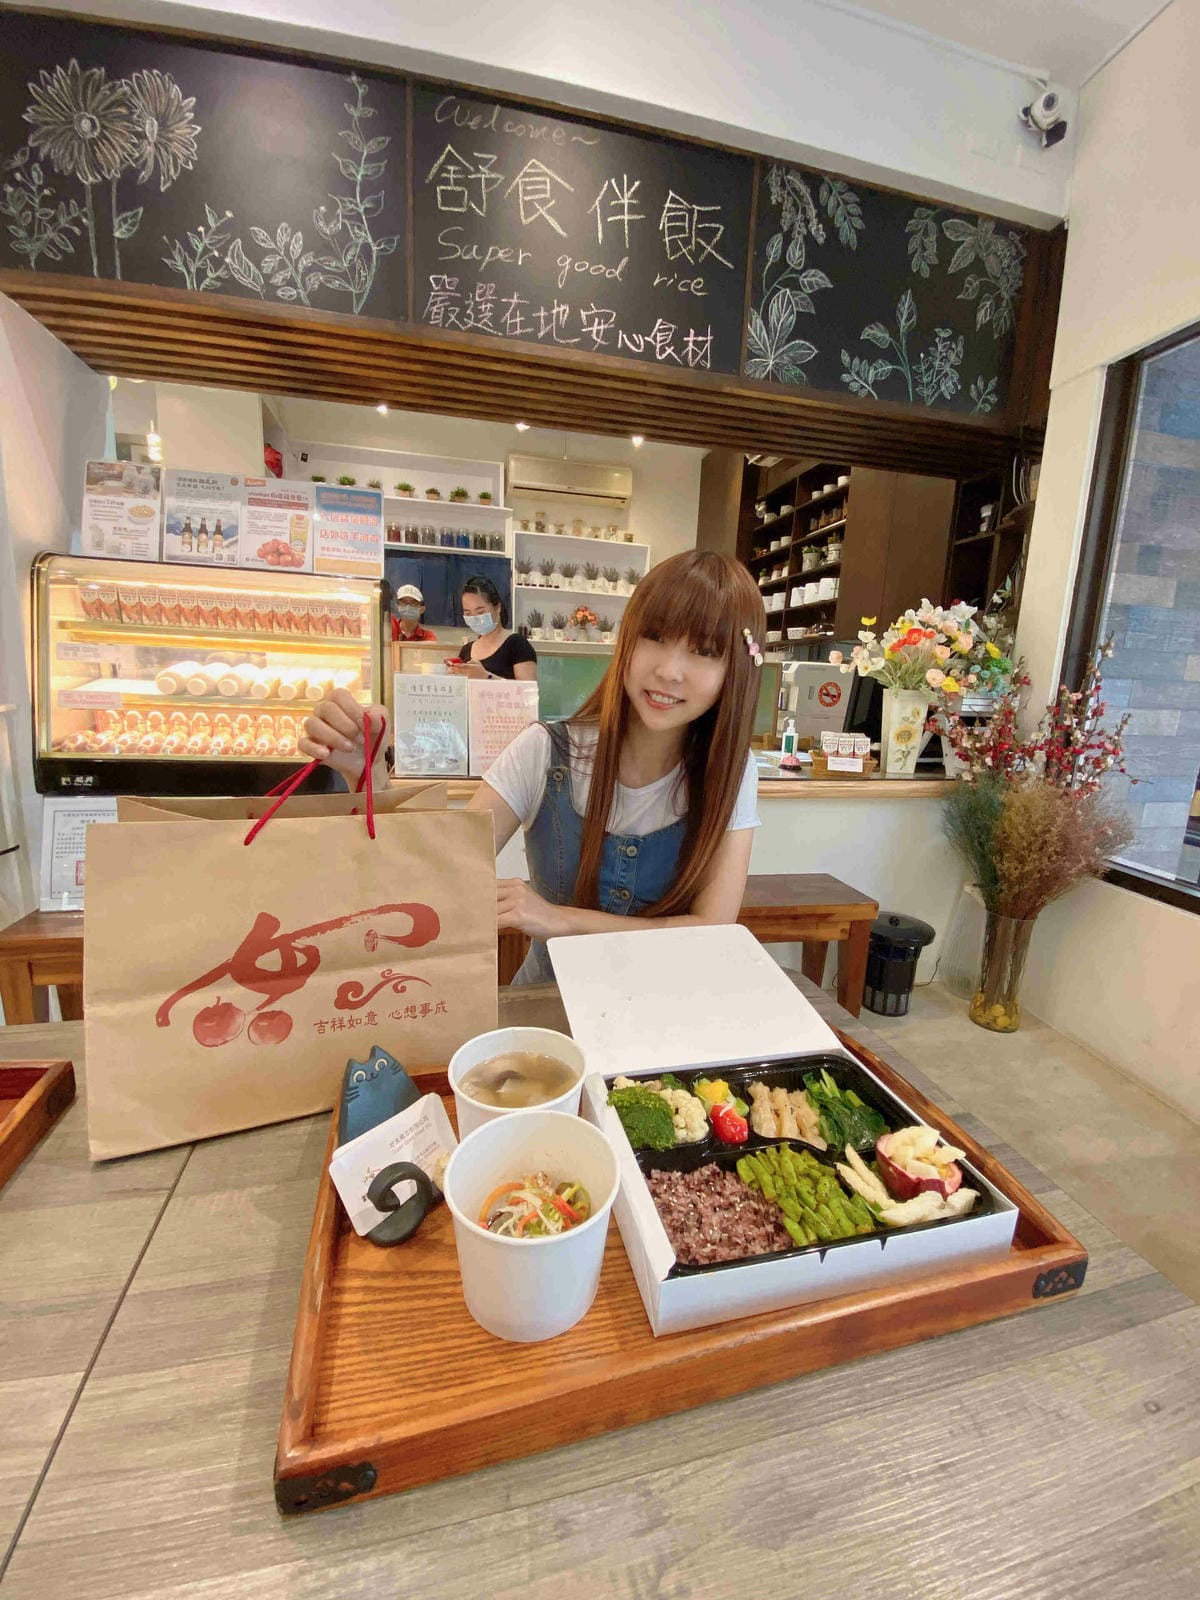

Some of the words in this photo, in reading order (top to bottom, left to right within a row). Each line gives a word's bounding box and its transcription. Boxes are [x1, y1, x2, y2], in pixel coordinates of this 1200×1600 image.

[424, 143, 735, 270] 舒食伴飯
[438, 226, 532, 272] Super
[556, 256, 630, 290] good
[653, 271, 710, 297] rice
[422, 273, 714, 370] 嚴選在地安心食材
[313, 1010, 379, 1035] 吉祥如意
[387, 1000, 449, 1020] 心想事成
